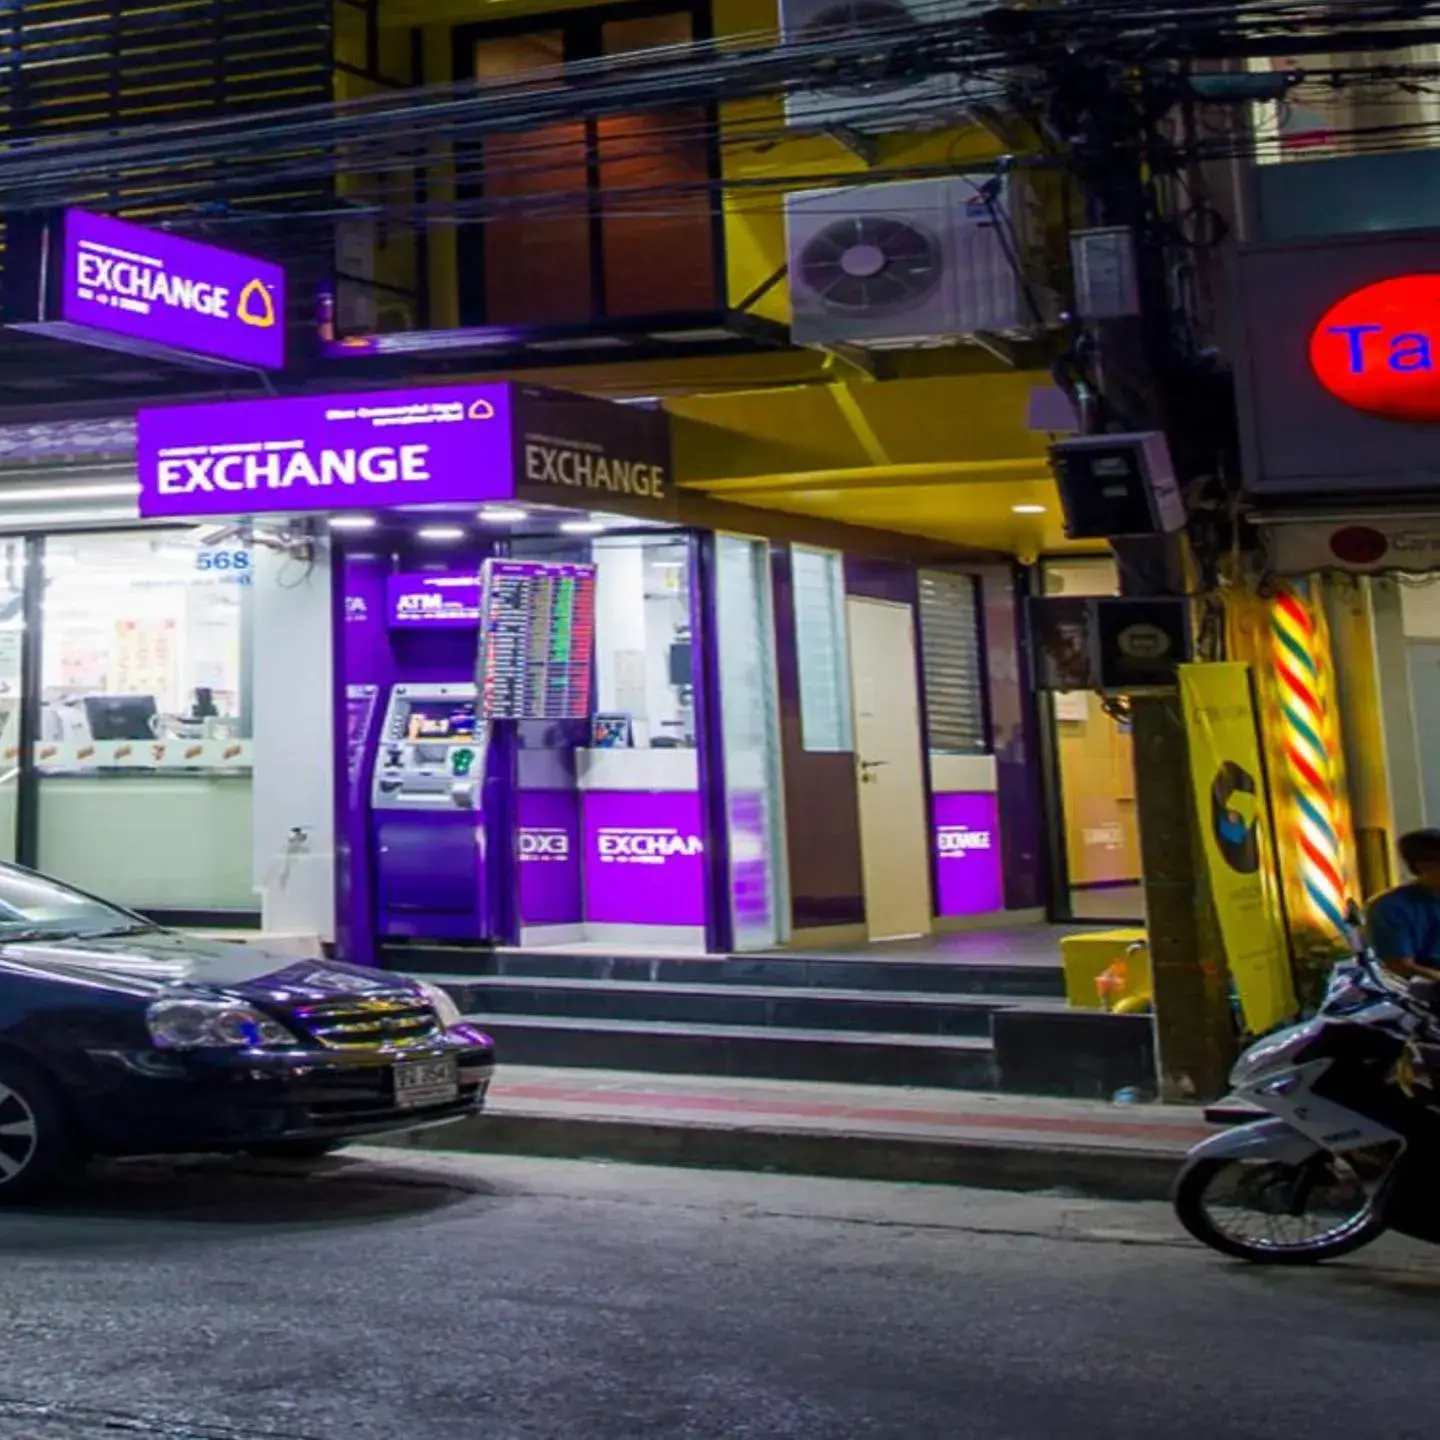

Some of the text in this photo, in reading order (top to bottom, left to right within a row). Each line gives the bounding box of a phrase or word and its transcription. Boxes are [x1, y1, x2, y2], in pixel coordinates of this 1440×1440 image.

[77, 251, 229, 319] EXCHANGE
[1326, 324, 1432, 373] Ta
[158, 444, 429, 494] EXCHANGE
[525, 444, 665, 498] EXCHANGE
[195, 550, 249, 570] 568
[397, 594, 442, 611] ATM
